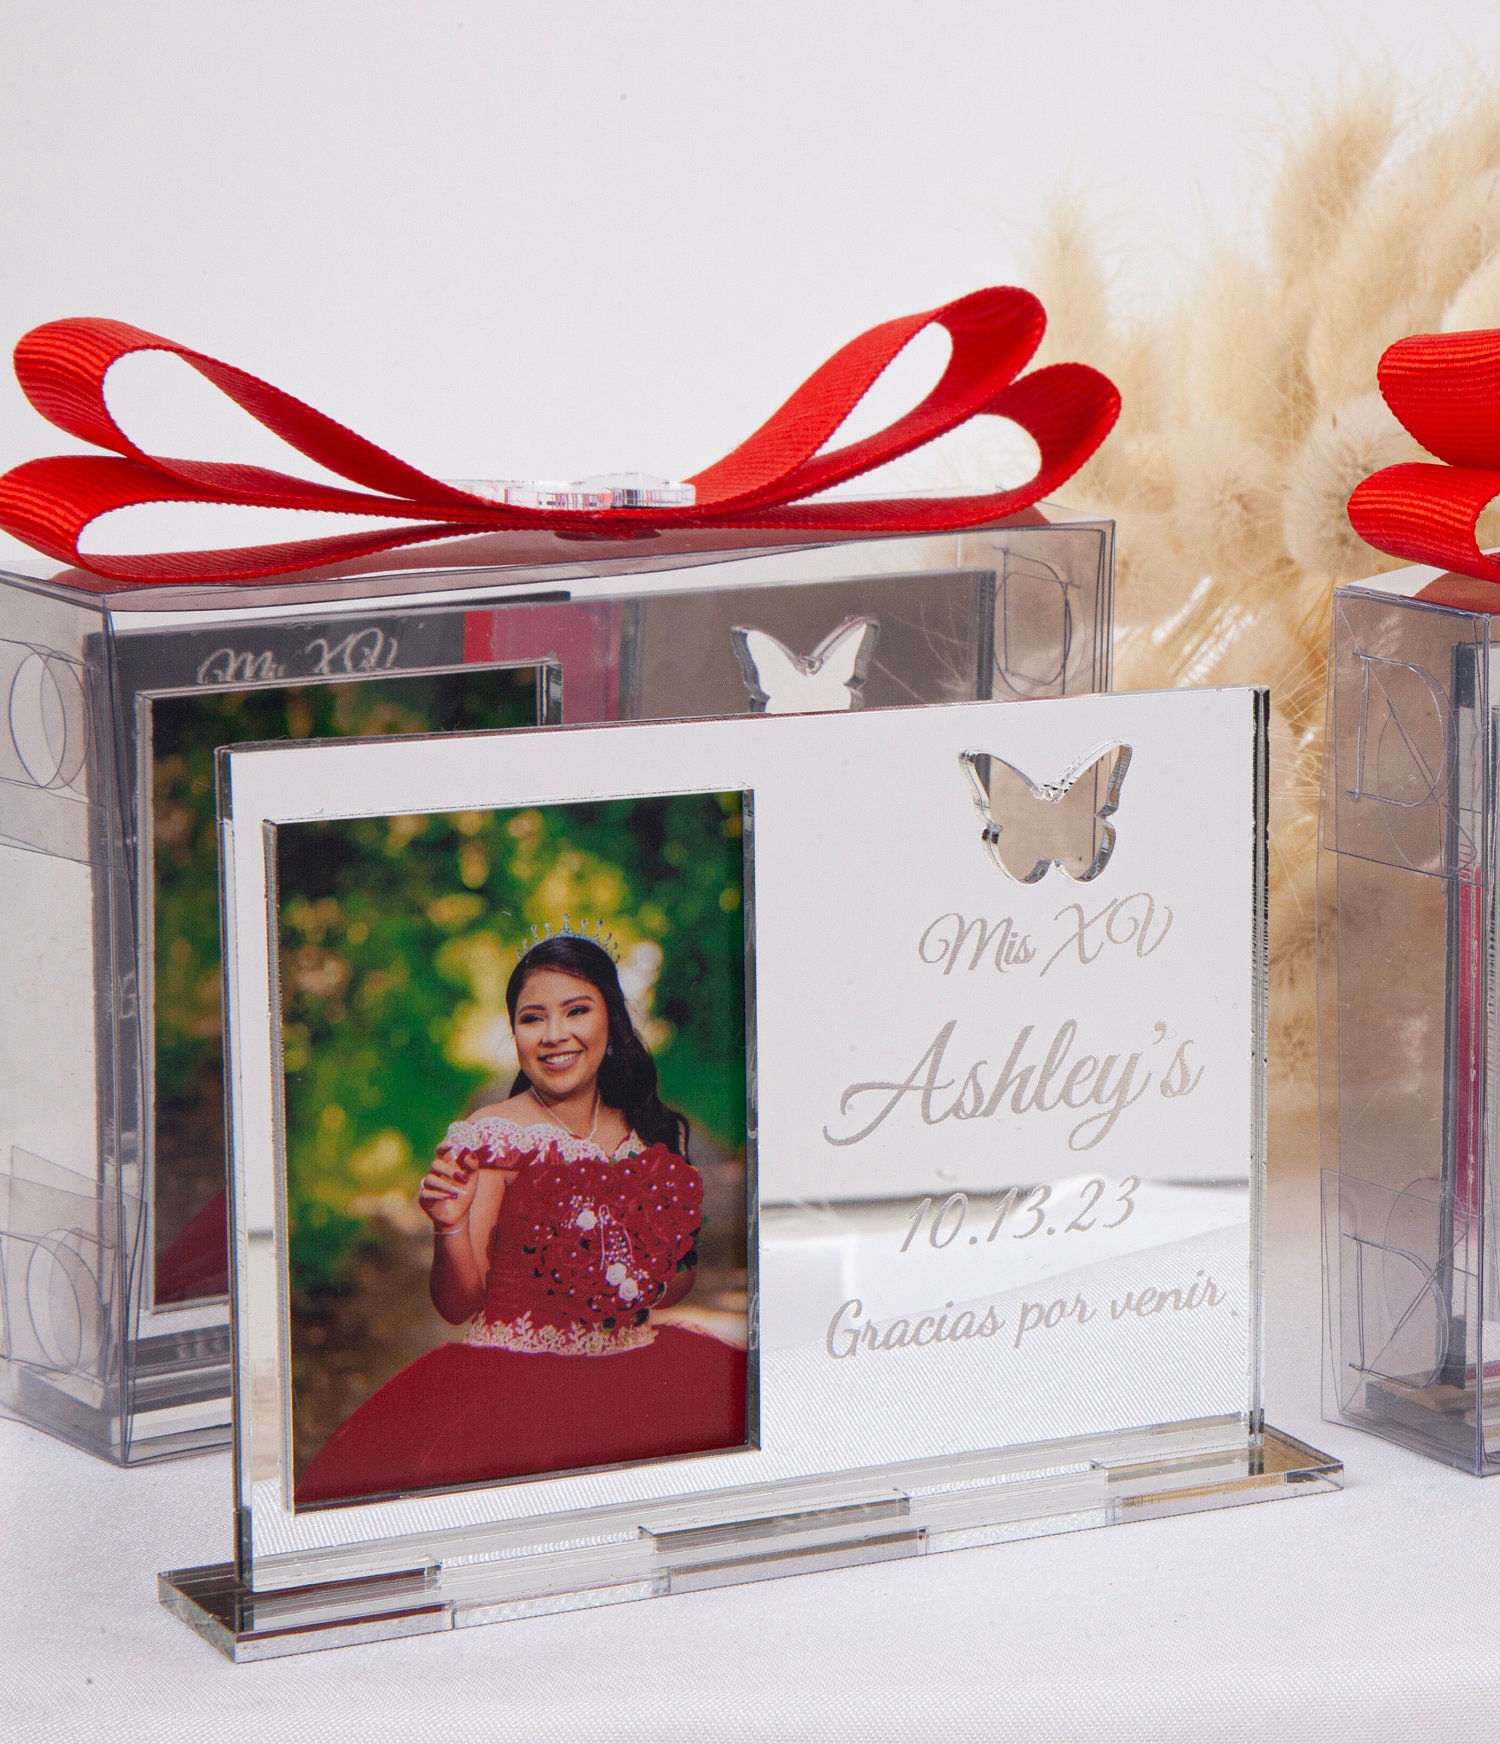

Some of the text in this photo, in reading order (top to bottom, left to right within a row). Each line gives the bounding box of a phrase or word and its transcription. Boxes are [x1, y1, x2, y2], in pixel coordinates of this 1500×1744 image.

[917, 891, 1174, 977] Mis XV
[822, 1019, 1205, 1151] Ashley's
[899, 1174, 1142, 1254] 10.13.23
[826, 1270, 1228, 1360] Gracias por venir
